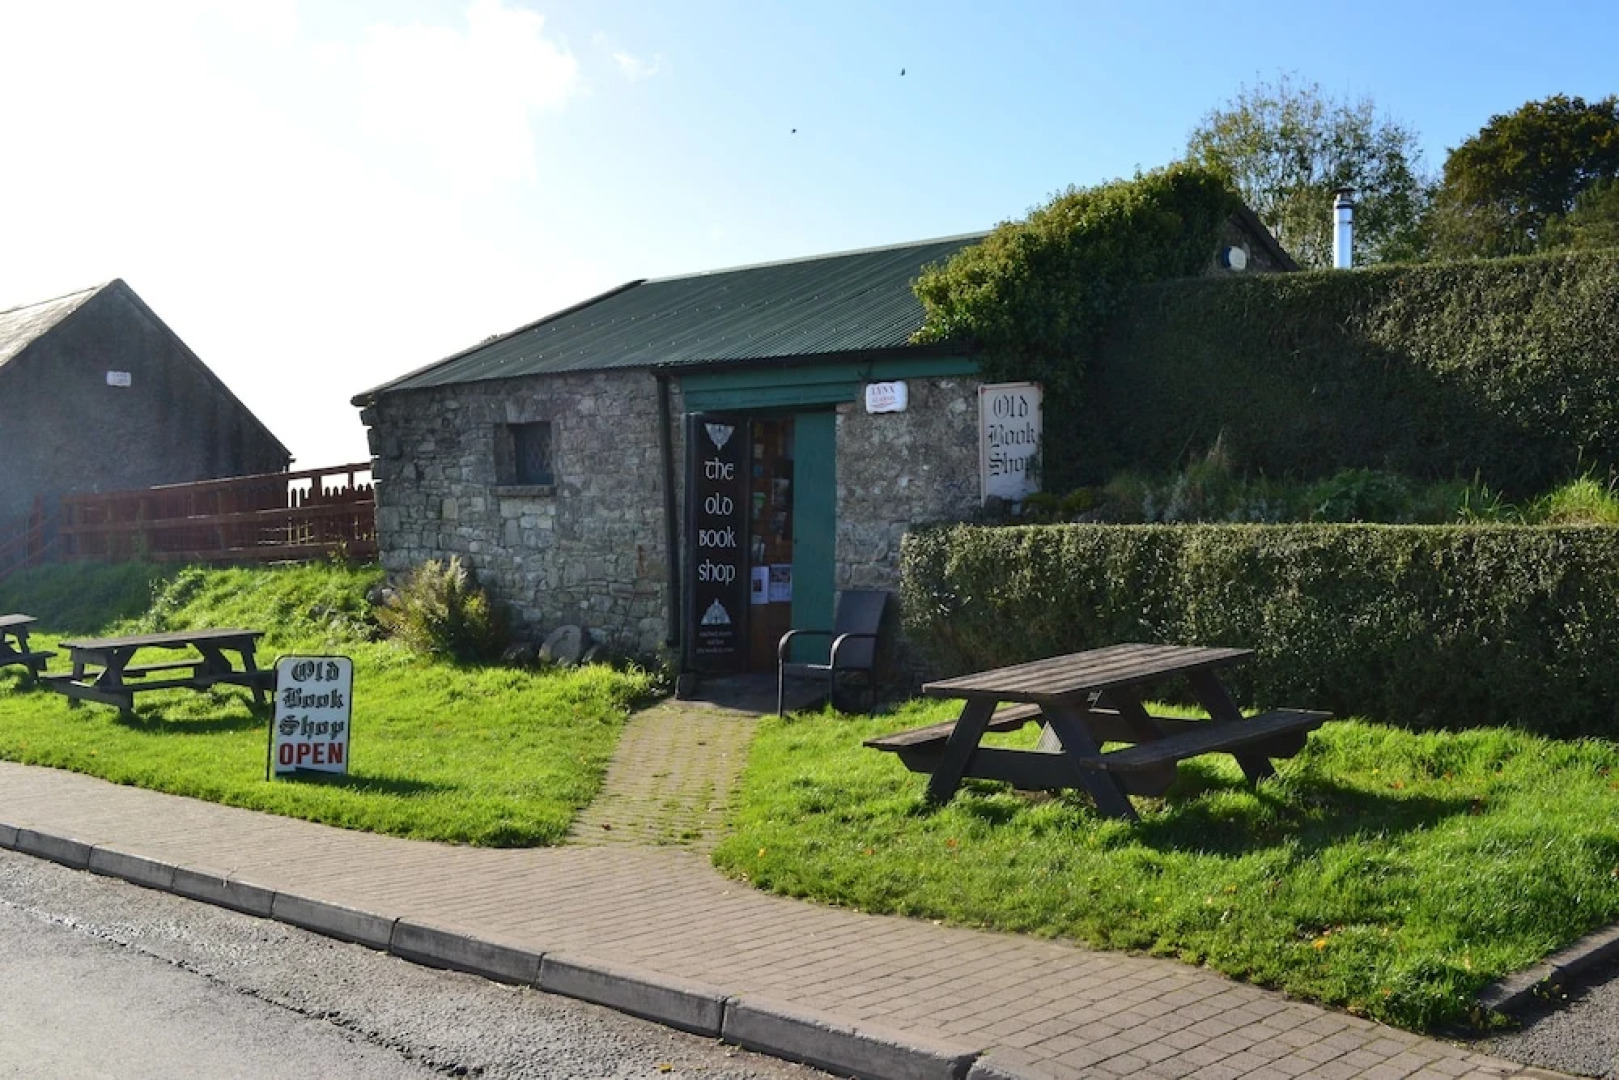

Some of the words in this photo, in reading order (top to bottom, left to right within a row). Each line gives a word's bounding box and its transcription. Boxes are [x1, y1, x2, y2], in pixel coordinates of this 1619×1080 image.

[993, 394, 1029, 419] Old
[988, 421, 1036, 448] Book
[698, 558, 736, 586] shop
[291, 661, 339, 682] Old
[283, 687, 344, 709] Book
[279, 714, 345, 741] Shop
[279, 742, 344, 766] OPEN
